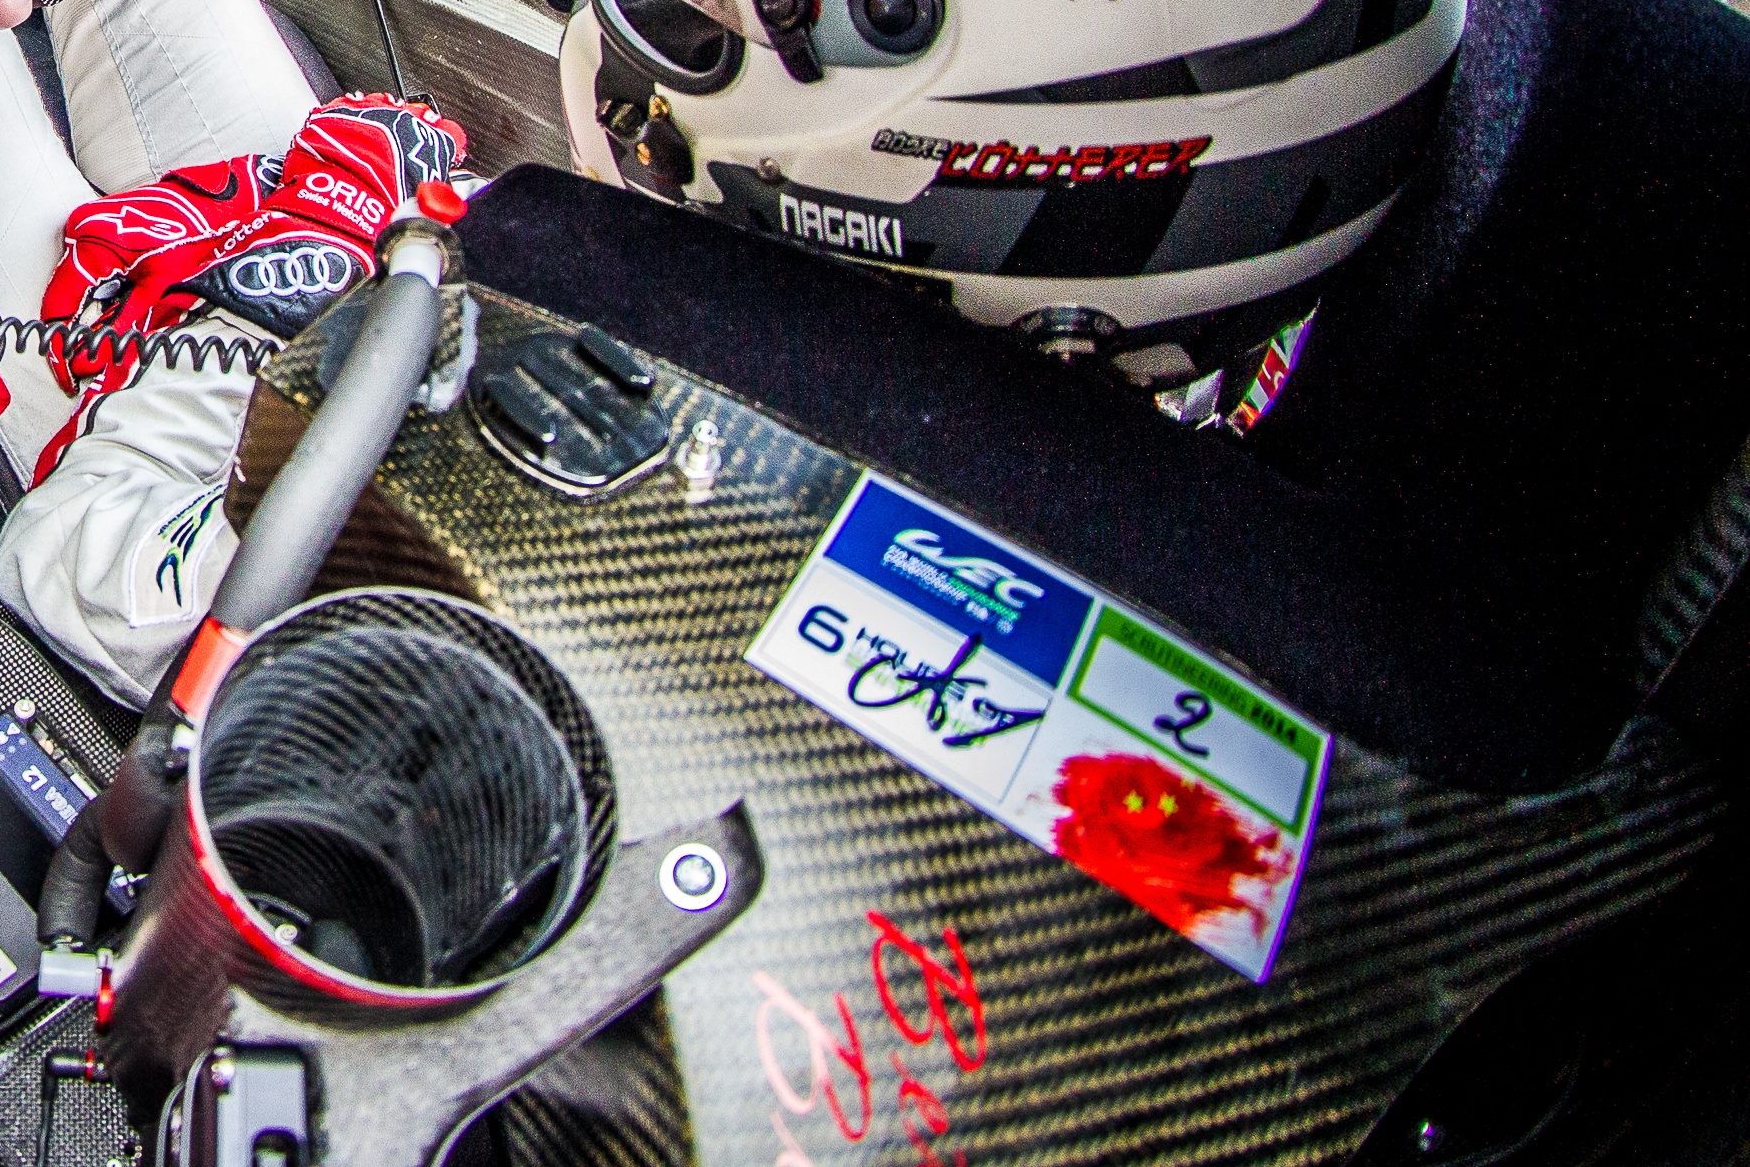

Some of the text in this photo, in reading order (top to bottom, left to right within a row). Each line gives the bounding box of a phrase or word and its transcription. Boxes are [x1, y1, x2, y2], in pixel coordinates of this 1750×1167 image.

[297, 188, 375, 235] Swiss Watches
[305, 172, 385, 225] ORIS
[213, 212, 290, 259] Lotter
[780, 192, 903, 259] NAGAKI
[894, 528, 1046, 609] WEC
[798, 604, 848, 653] 6
[1153, 690, 1212, 760] 2
[1251, 704, 1297, 743] 2014
[21, 764, 48, 791] L2
